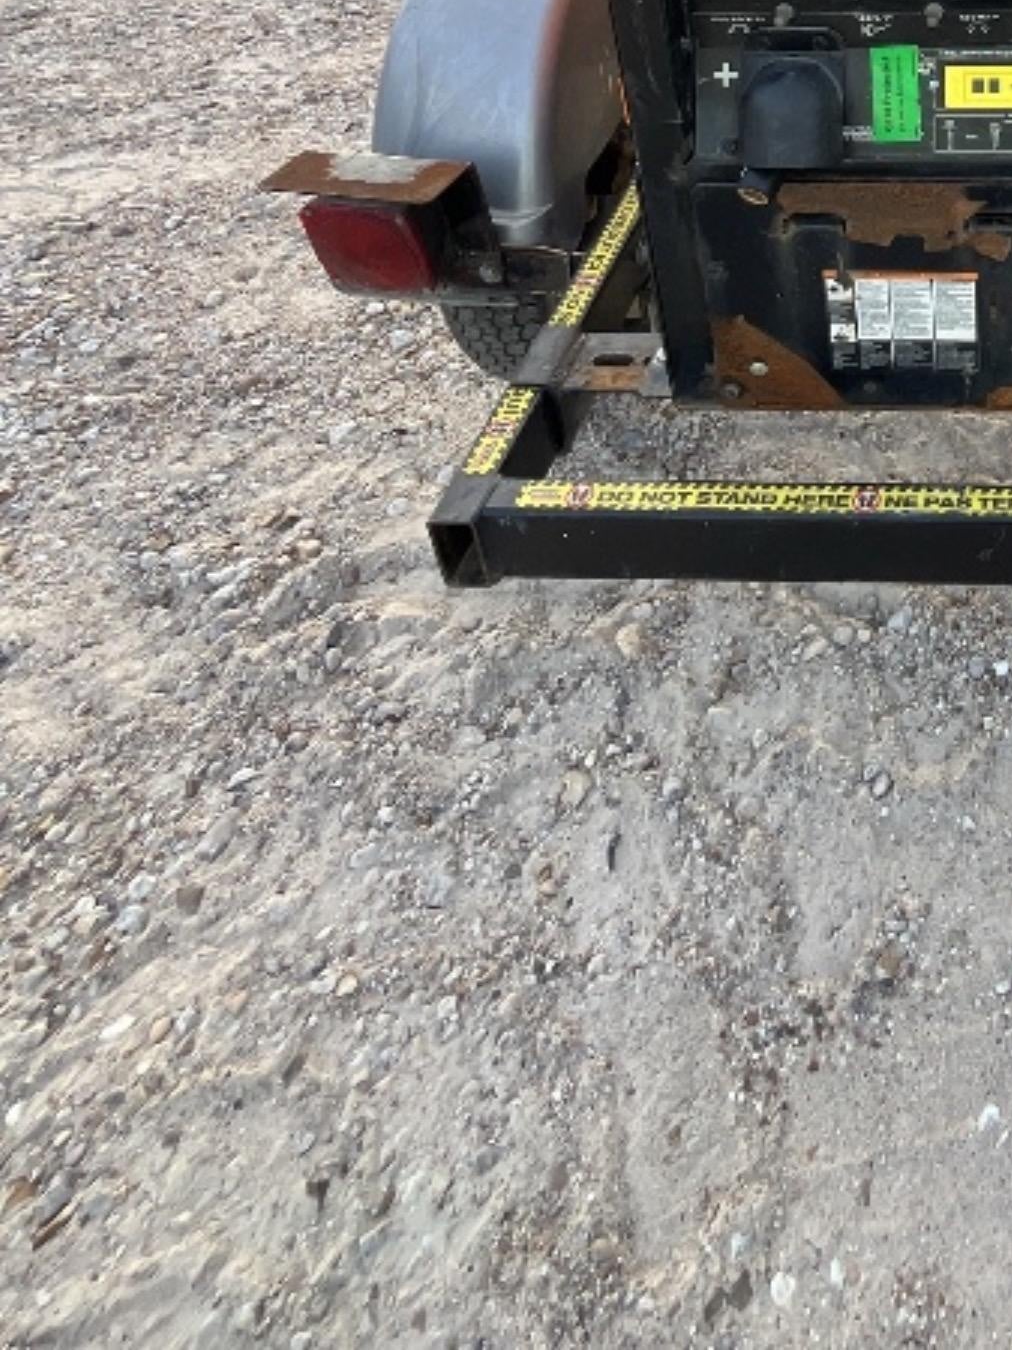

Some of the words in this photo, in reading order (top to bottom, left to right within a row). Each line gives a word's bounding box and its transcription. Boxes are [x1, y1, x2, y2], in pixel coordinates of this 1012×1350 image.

[596, 491, 632, 503] DO
[639, 491, 693, 504] NOT
[695, 491, 778, 505] STAND
[782, 493, 850, 508] HERE
[884, 495, 919, 508] NE
